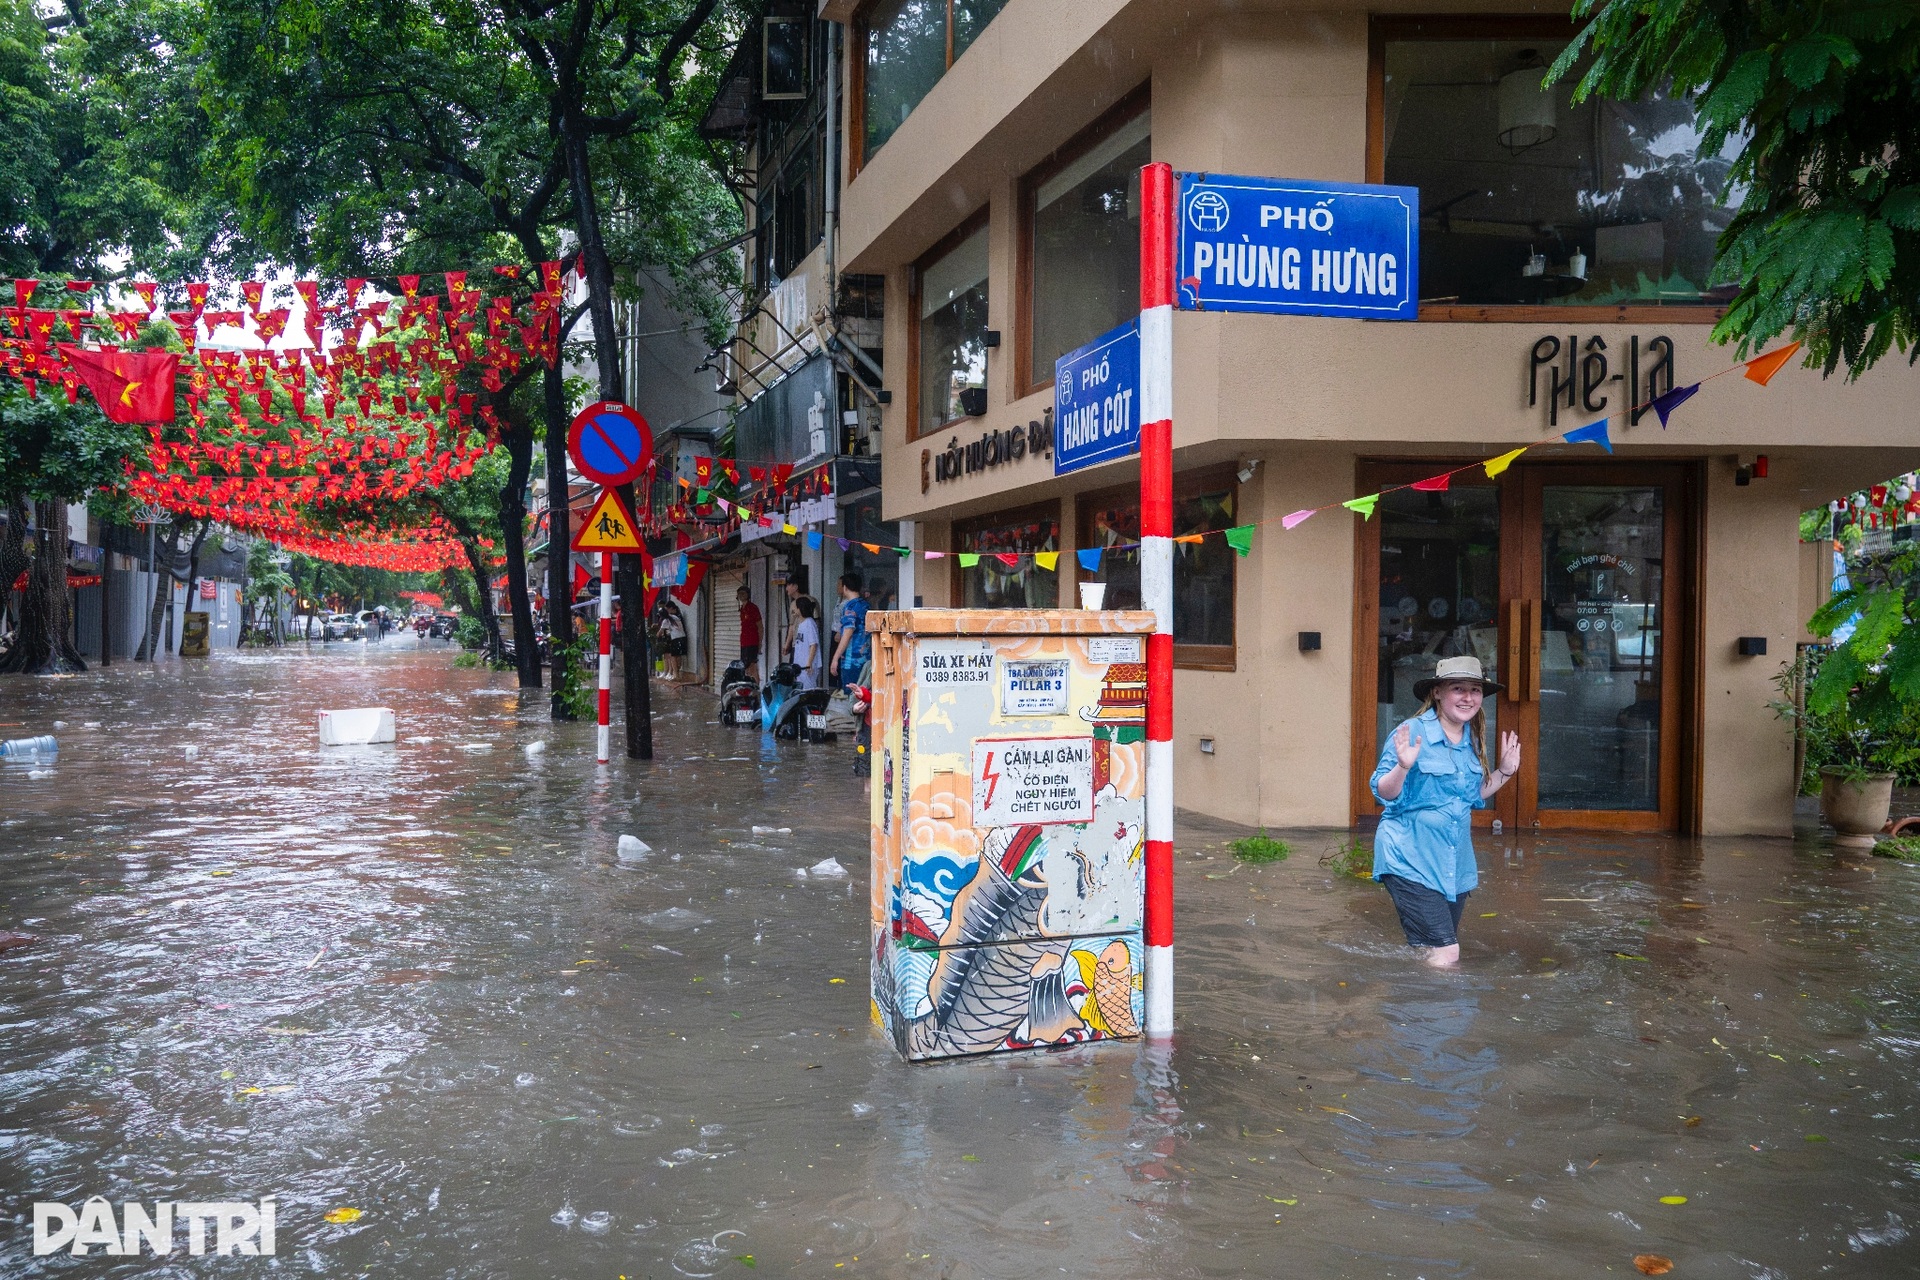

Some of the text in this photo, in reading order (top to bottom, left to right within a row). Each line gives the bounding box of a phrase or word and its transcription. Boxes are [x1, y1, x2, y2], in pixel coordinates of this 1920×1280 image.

[1260, 198, 1335, 232] PHỐ
[1193, 234, 1397, 297] PHÙNG HƯNG
[1082, 349, 1110, 391] PHỐ
[1063, 383, 1133, 452] HÀNG CÓT
[965, 428, 1026, 475] HƯƠNG
[1581, 554, 1599, 565] bạn
[1599, 553, 1617, 564] ghé
[922, 651, 994, 669] SỬA XE MÁY
[1058, 668, 1064, 677] 2
[1010, 680, 1062, 691] PILLAR 3
[1043, 774, 1069, 787] ĐIỆN
[1015, 788, 1047, 800] NGUY
[1043, 798, 1081, 811] NGƯỜI
